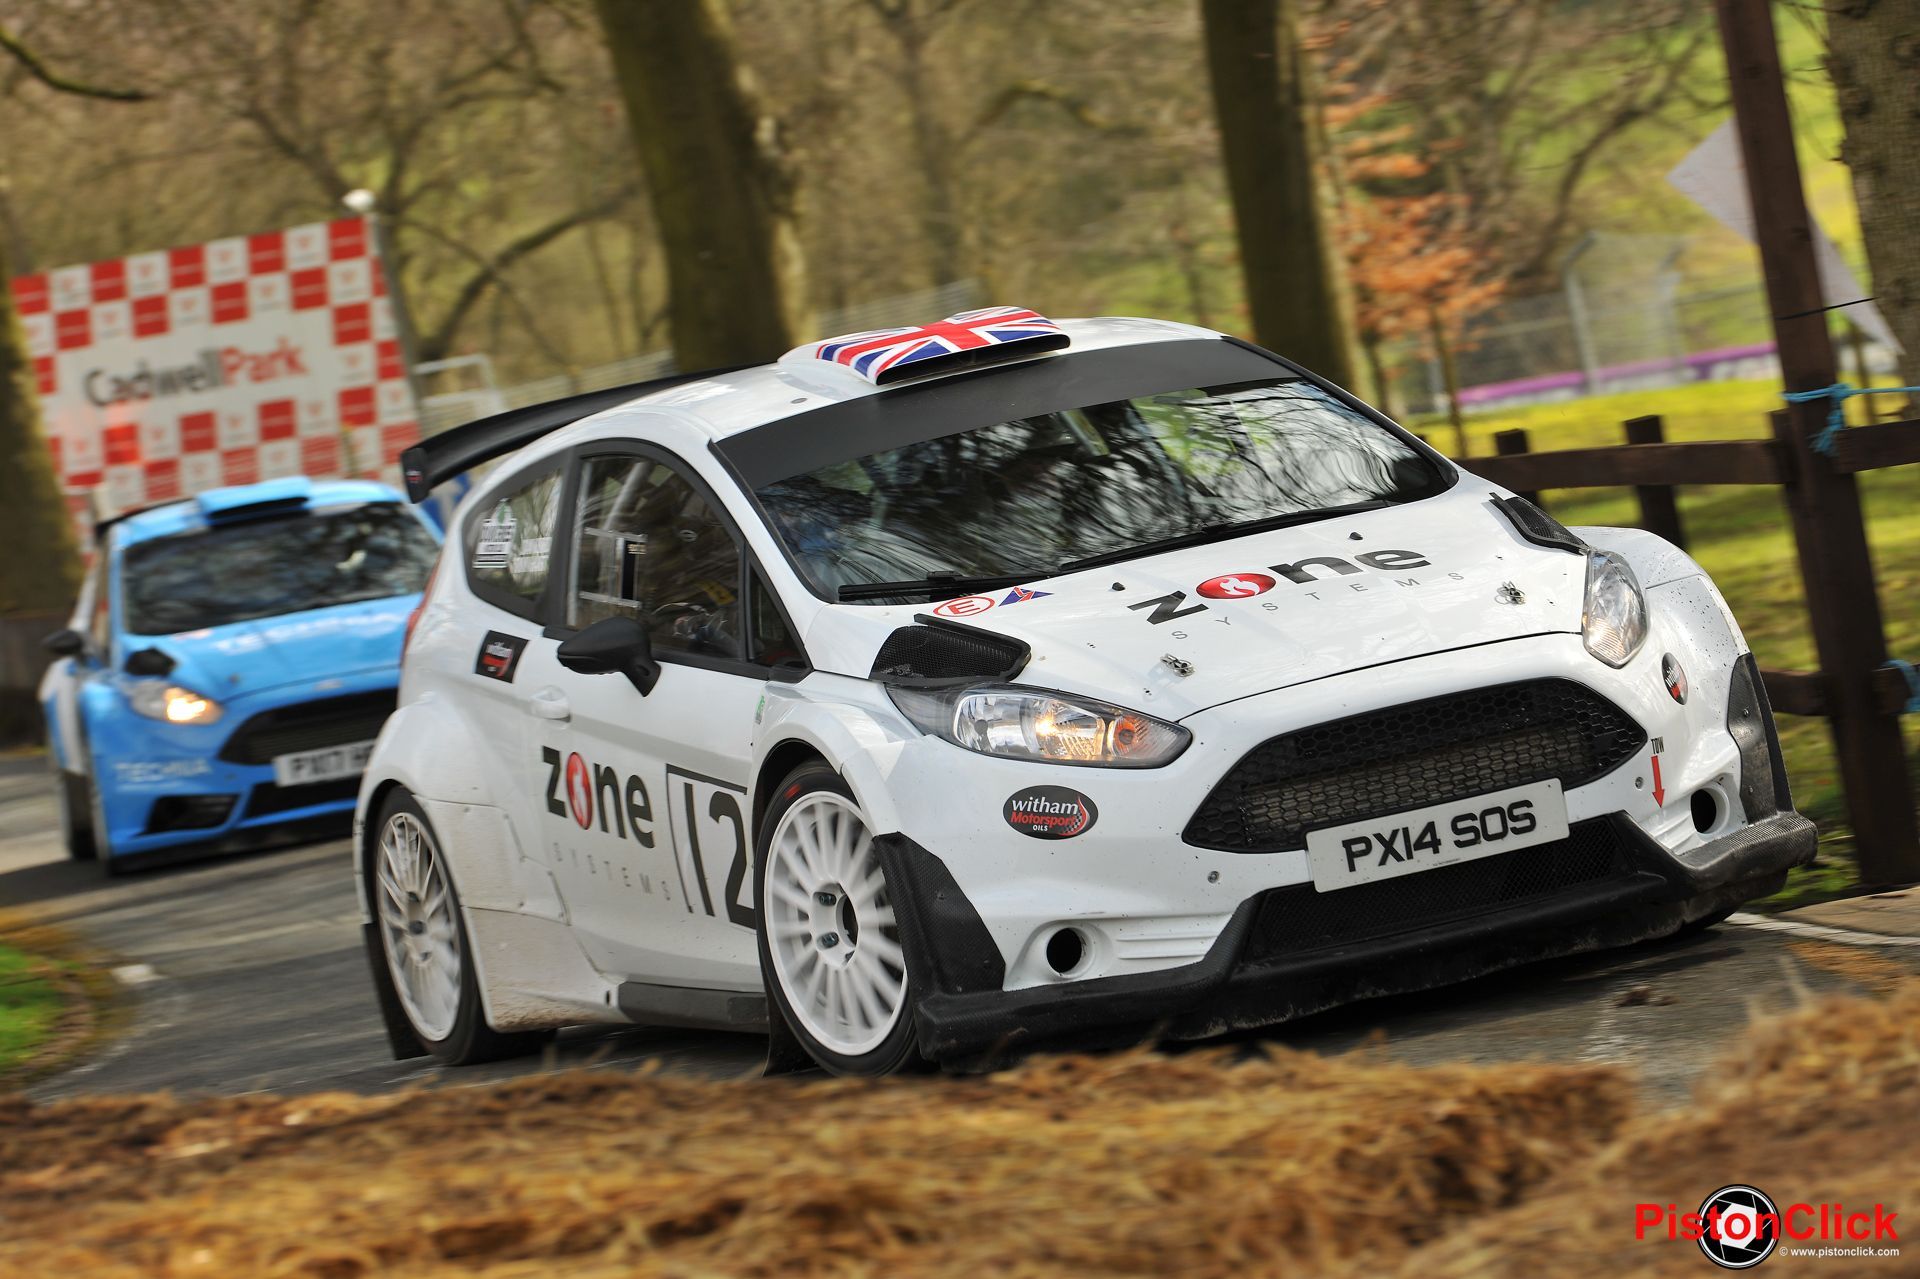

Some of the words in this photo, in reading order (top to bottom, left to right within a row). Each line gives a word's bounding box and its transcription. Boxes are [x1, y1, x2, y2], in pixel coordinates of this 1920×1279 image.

[1651, 736, 1665, 755] TOW
[1012, 796, 1079, 815] witham
[1010, 811, 1077, 828] Motorsport
[1032, 824, 1048, 832] OILS
[1342, 821, 1442, 873] PX14
[1451, 800, 1537, 848] SOS
[684, 782, 758, 930] 12
